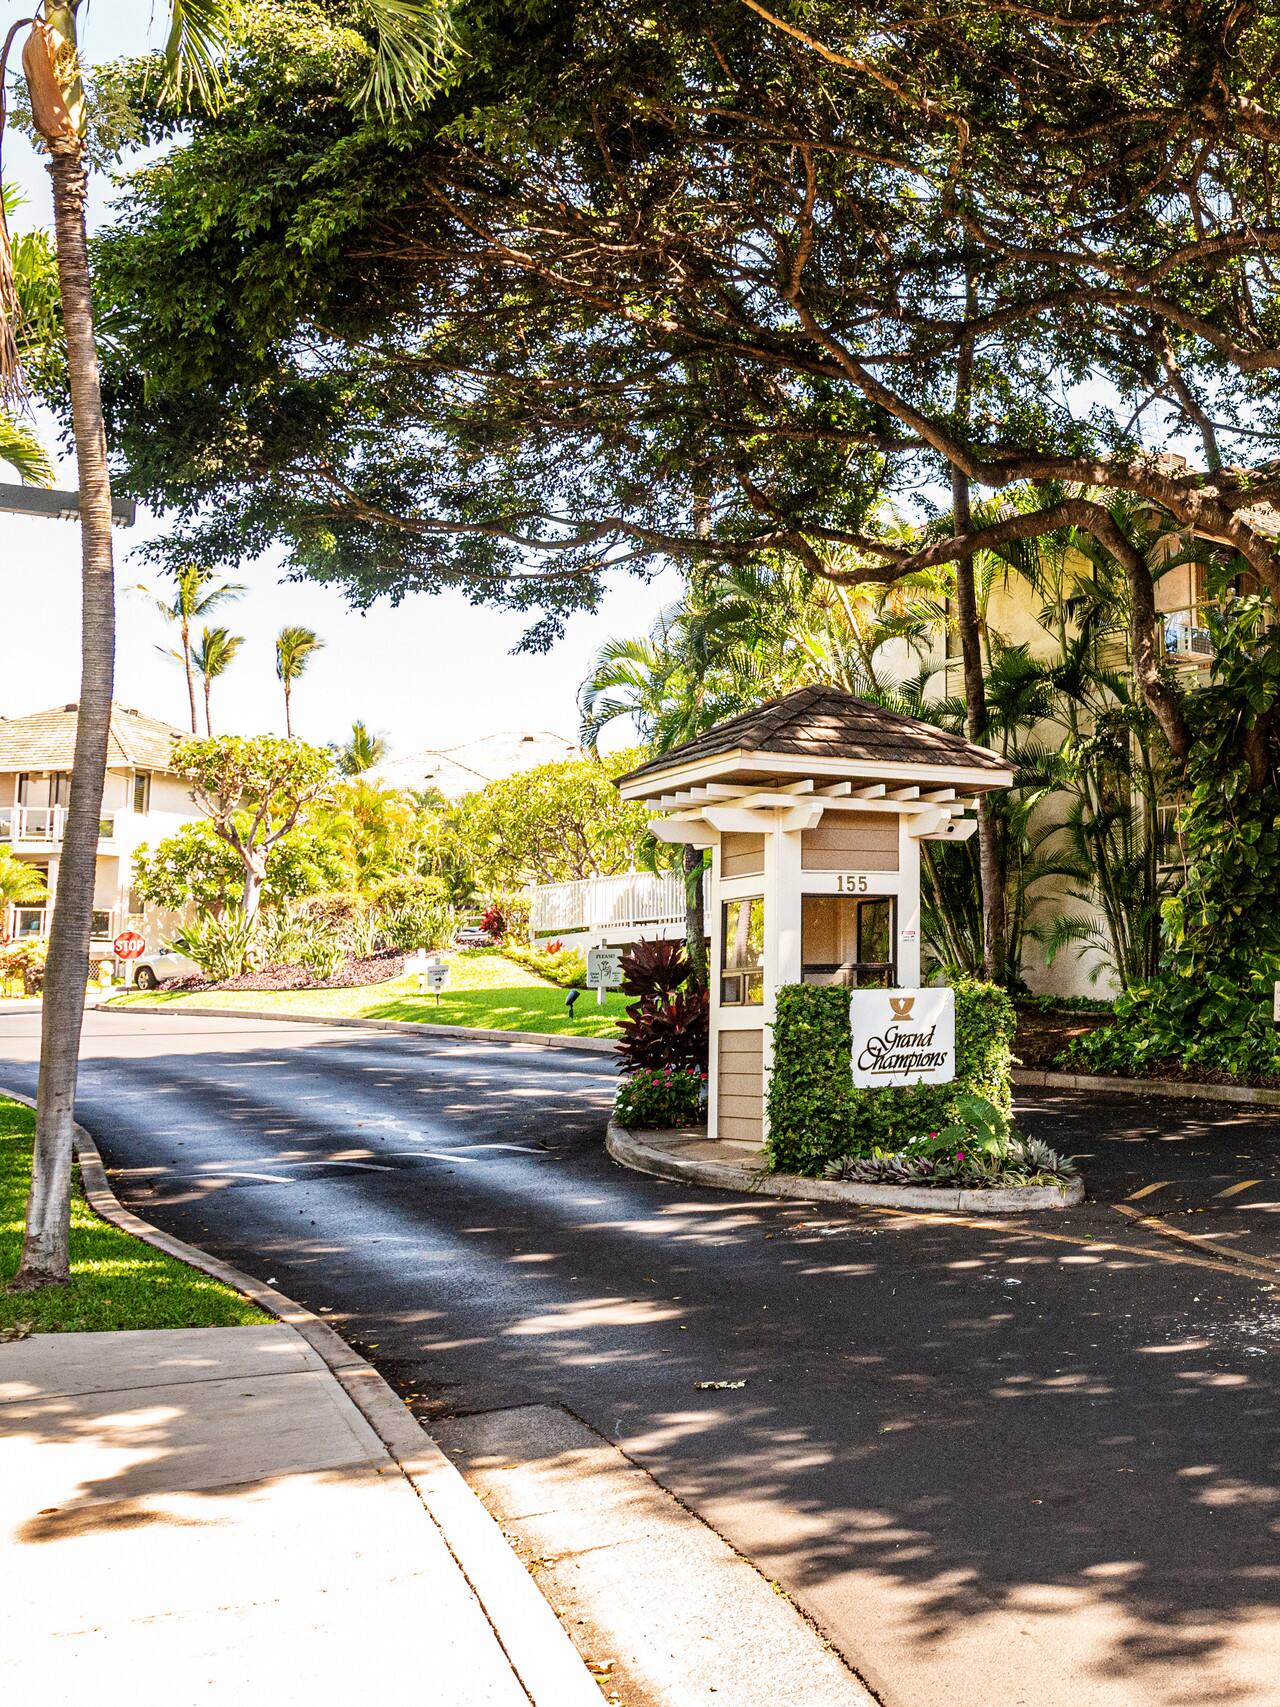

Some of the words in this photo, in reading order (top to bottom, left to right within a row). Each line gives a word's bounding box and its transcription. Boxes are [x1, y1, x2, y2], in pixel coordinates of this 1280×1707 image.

[836, 875, 868, 892] 155
[115, 940, 144, 952] STOP
[868, 1024, 937, 1053] Grand
[858, 1046, 948, 1076] Champions
